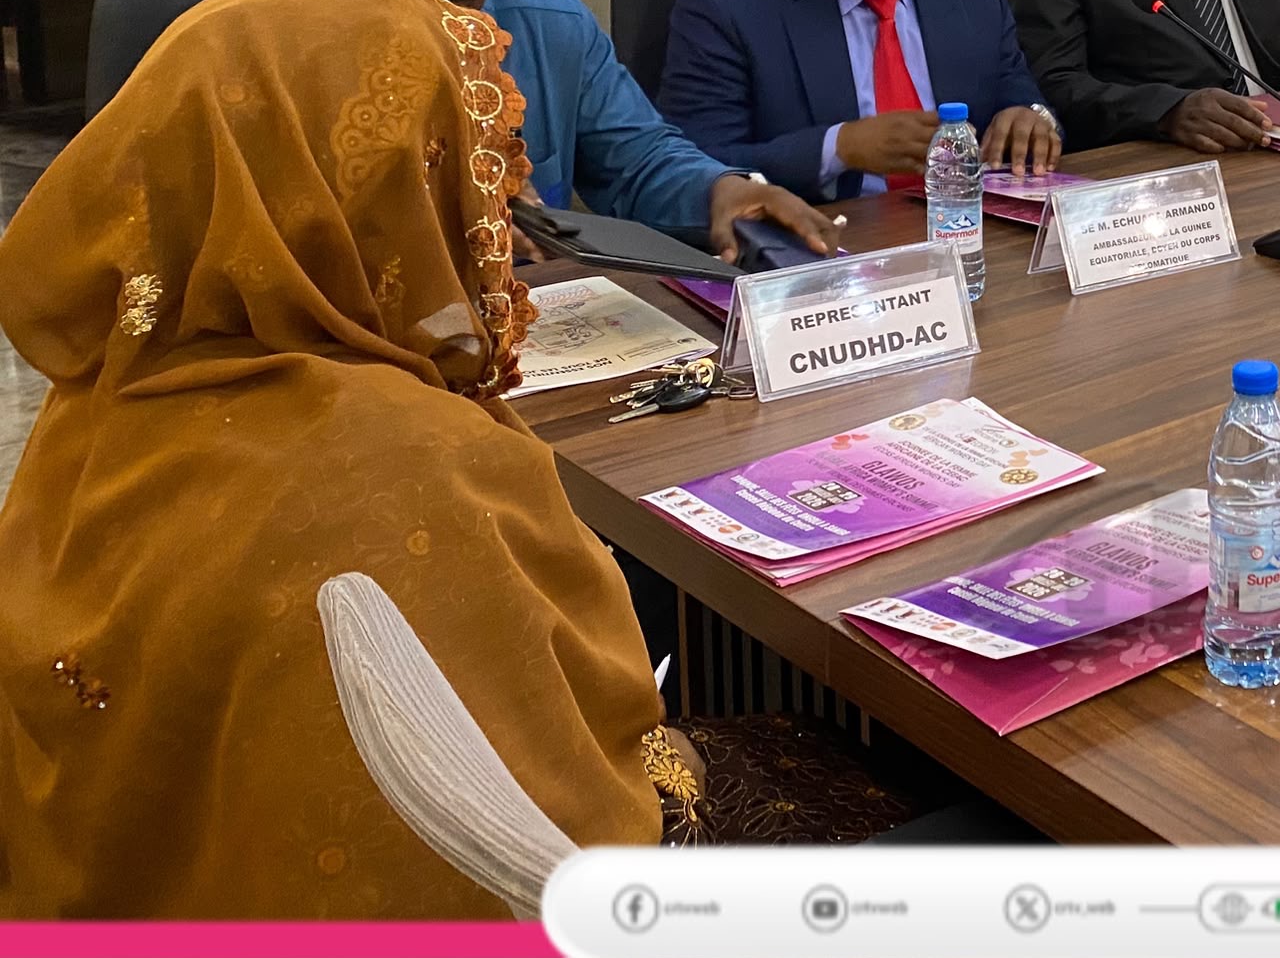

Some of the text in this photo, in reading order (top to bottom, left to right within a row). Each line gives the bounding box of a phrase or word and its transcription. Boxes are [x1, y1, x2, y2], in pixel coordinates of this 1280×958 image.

[1098, 223, 1111, 231] M.
[1165, 202, 1216, 219] ARMANDO
[1170, 228, 1180, 236] LA
[1181, 221, 1212, 234] GUINEE
[935, 228, 978, 239] Supermont
[1180, 239, 1192, 248] DU
[1194, 234, 1220, 246] CORPS
[790, 321, 947, 373] CNUDHD-AC
[862, 460, 925, 490] GLAWOS
[1086, 542, 1159, 570] GLAWOS
